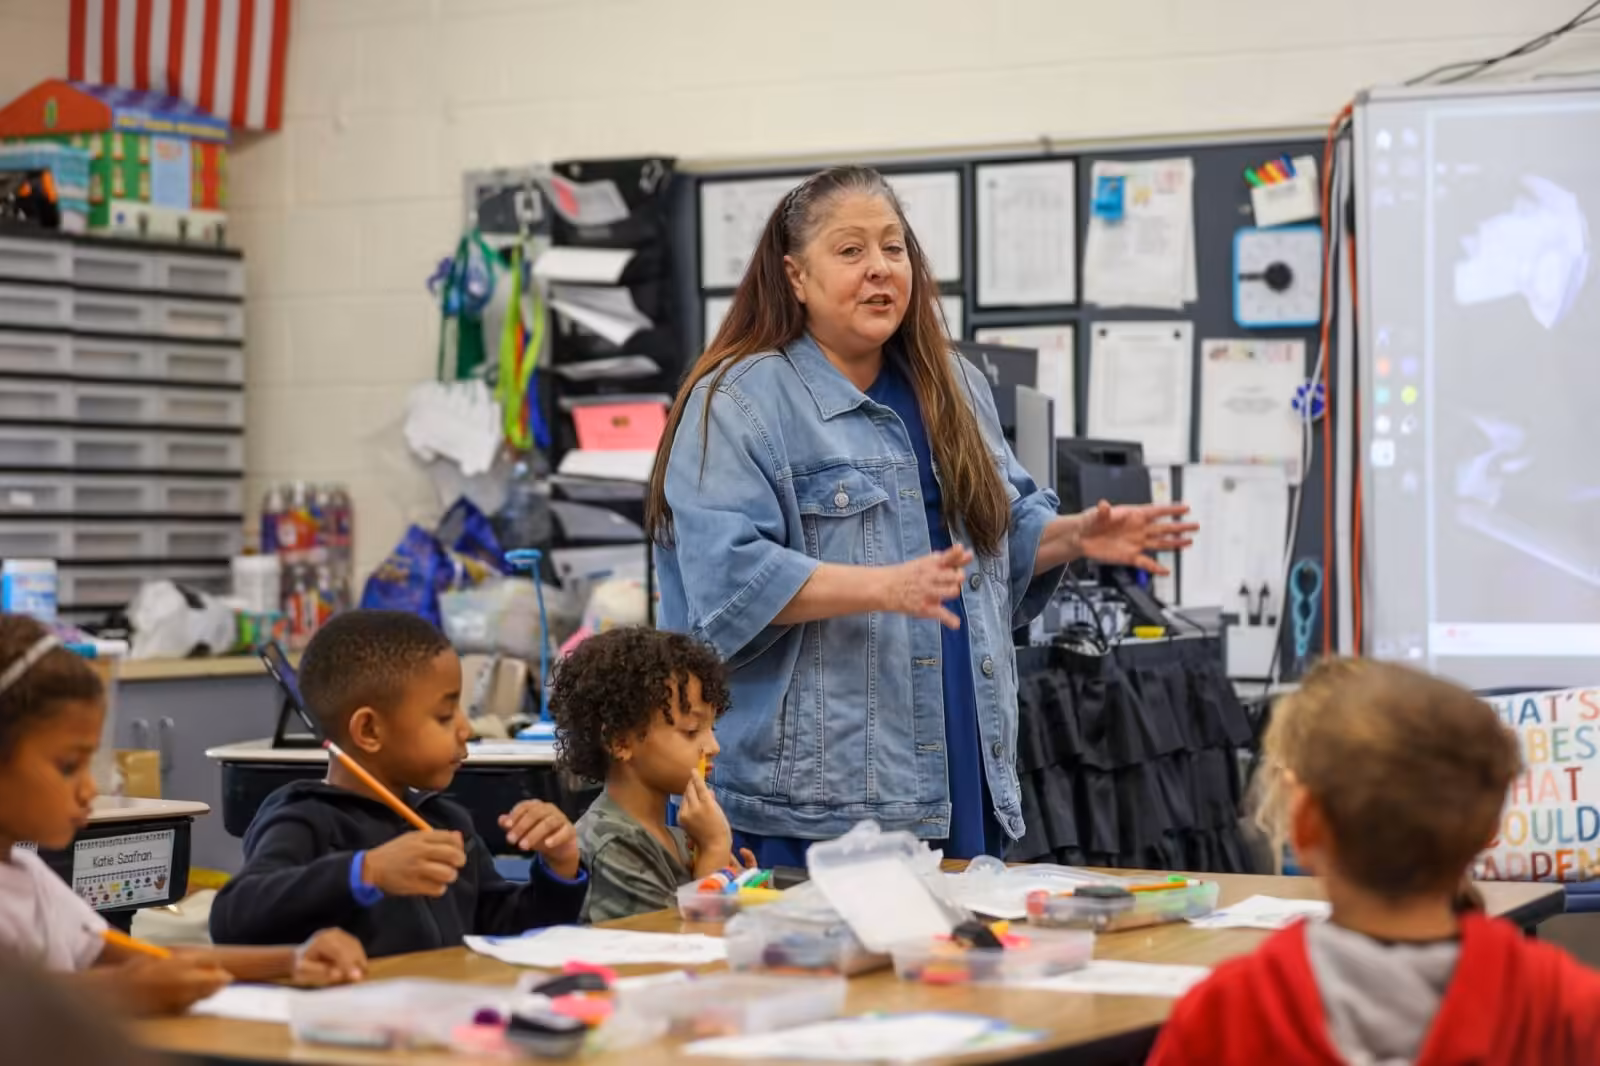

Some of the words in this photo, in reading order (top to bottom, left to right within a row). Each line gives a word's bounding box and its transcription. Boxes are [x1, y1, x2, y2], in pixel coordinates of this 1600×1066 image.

[1493, 691, 1600, 724] HAT'S
[1527, 726, 1600, 763] BES
[1510, 767, 1583, 805] HAT
[1484, 805, 1600, 849] OULD
[93, 855, 114, 867] Katie
[117, 850, 152, 865] Szafran
